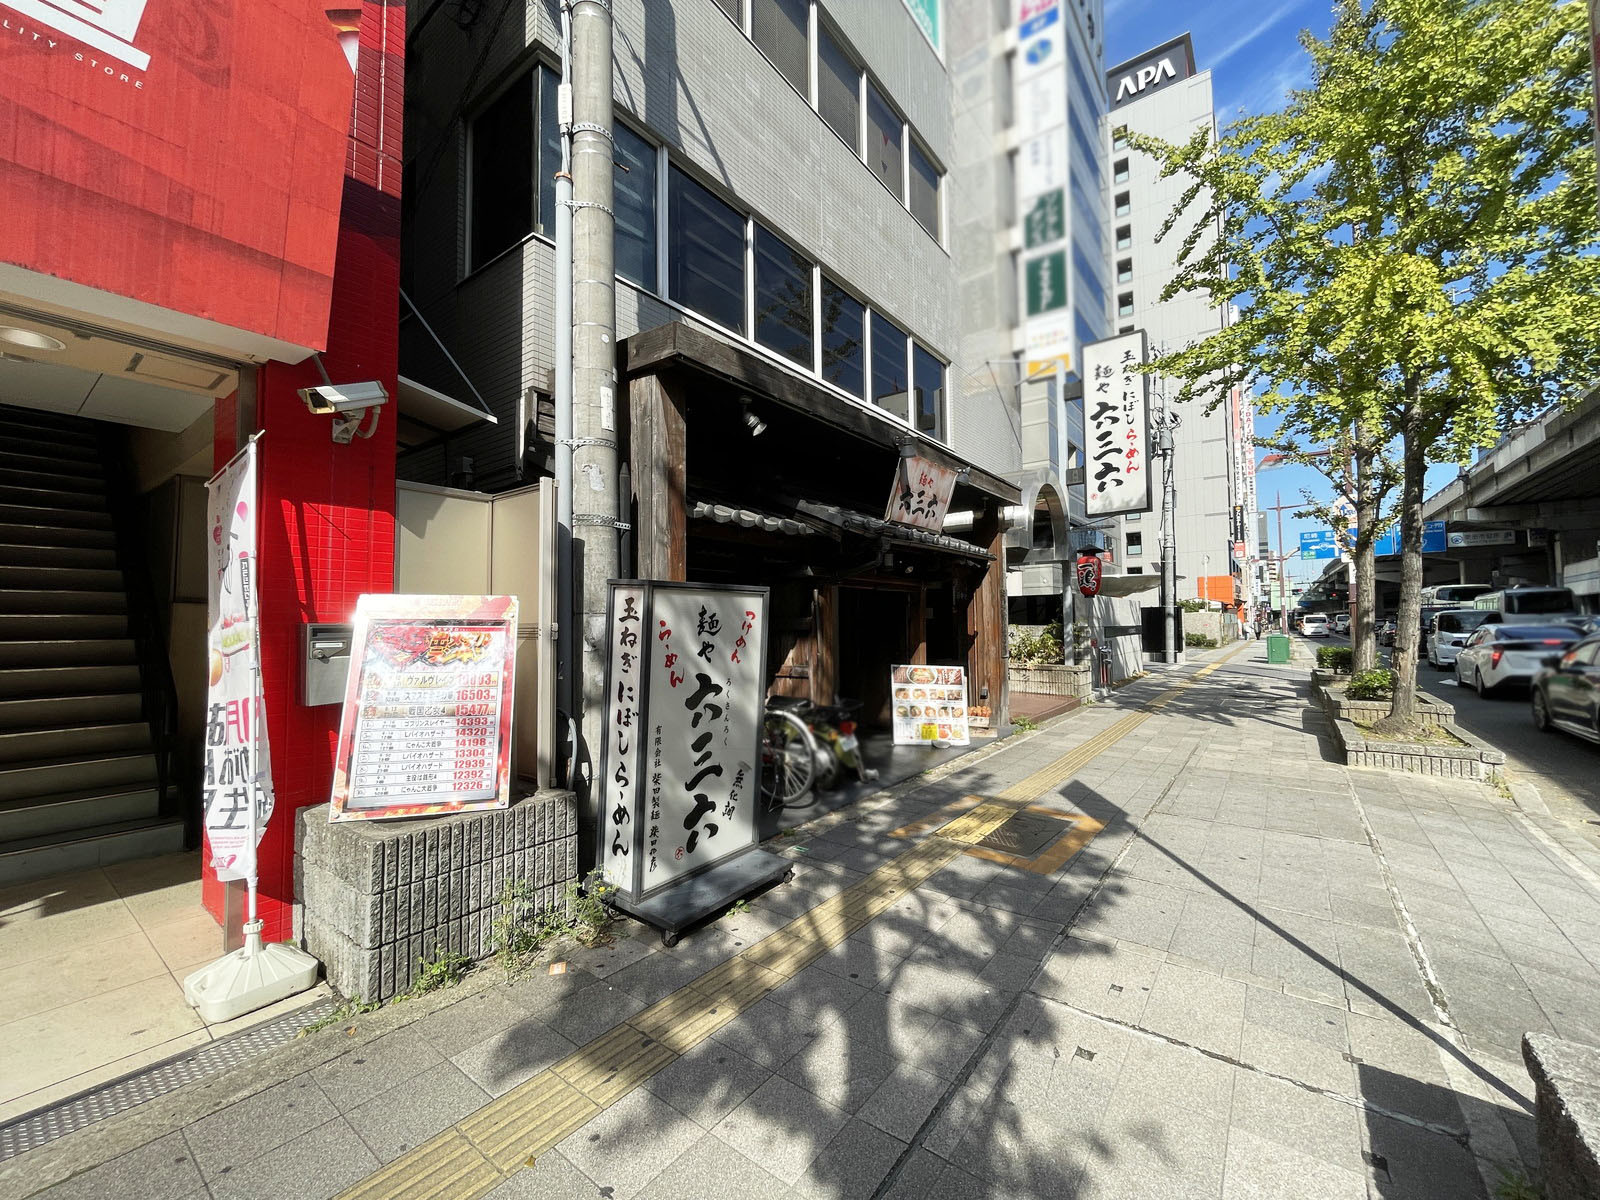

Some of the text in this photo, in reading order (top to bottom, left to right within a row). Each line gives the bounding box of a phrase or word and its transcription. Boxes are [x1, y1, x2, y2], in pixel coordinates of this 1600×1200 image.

[3, 19, 143, 89] LITY STORE
[1116, 57, 1176, 101] APA
[1089, 401, 1123, 493] 六三六
[730, 610, 756, 664] つけめん
[456, 689, 491, 701] 16503
[455, 703, 489, 717] 15477
[722, 677, 733, 747] ろくさんろく
[456, 717, 488, 726] 14393
[455, 727, 487, 736] 14320
[455, 738, 486, 747] 14198
[454, 749, 485, 758] 13304
[454, 759, 485, 768] 12939
[683, 672, 724, 854] 六三六
[453, 770, 484, 780] 12392
[452, 781, 483, 790] 12326
